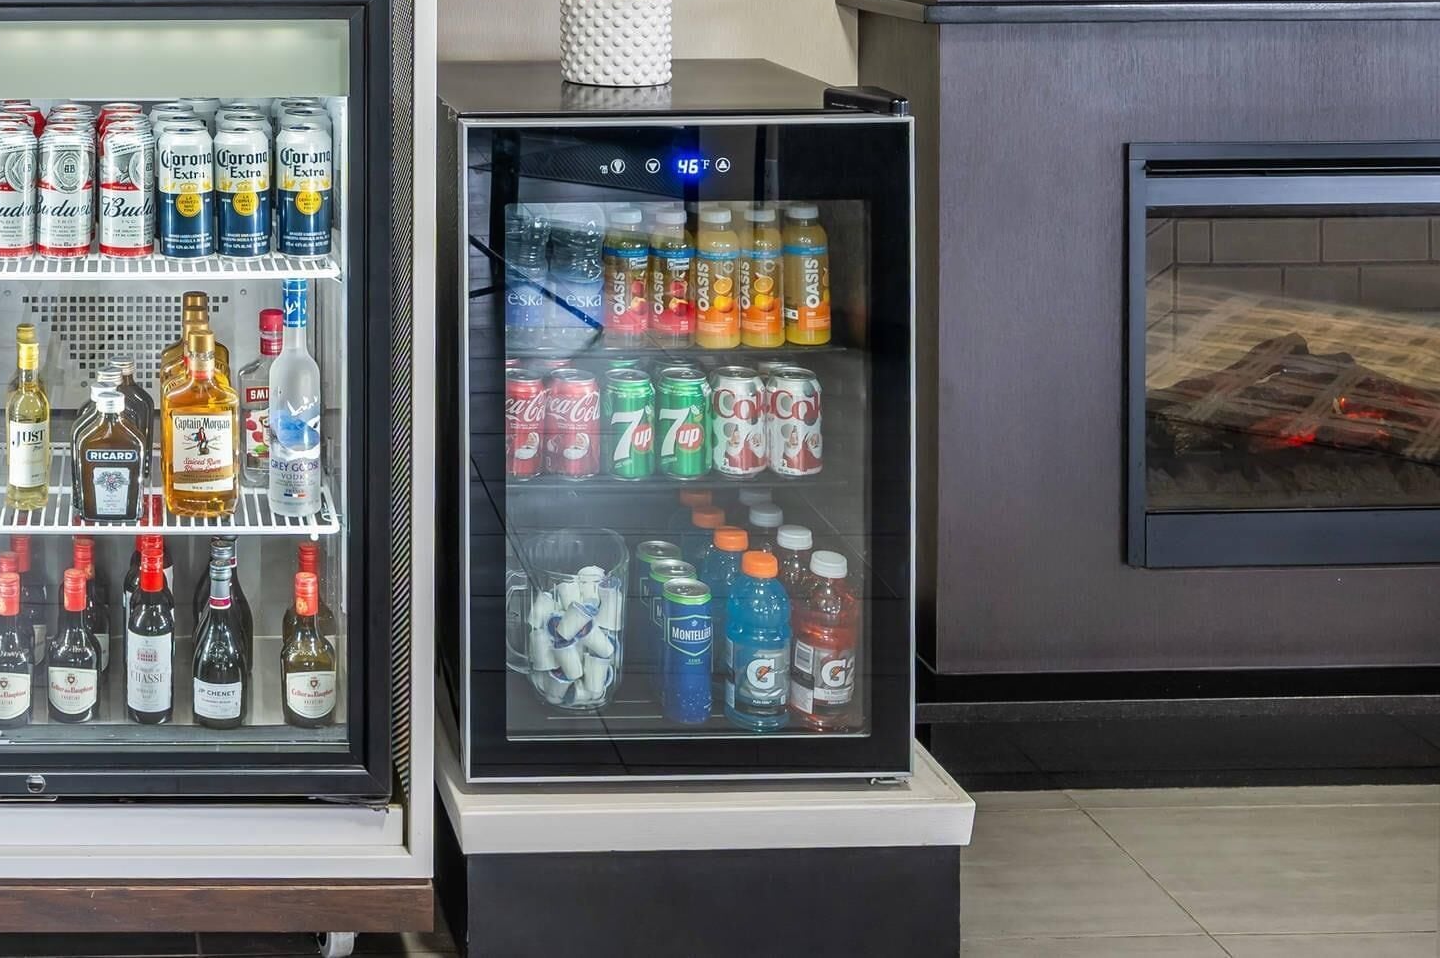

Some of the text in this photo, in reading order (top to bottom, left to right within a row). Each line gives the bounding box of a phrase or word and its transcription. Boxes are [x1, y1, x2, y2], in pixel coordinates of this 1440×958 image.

[161, 149, 211, 170] Corona
[217, 148, 268, 170] Corona
[280, 147, 332, 170] Corona
[677, 159, 698, 174] 46
[230, 167, 261, 178] Extra
[293, 165, 325, 177] Extra
[614, 272, 625, 316] OASIS
[654, 272, 664, 315] OASIS
[698, 261, 709, 312] OASIS
[741, 261, 751, 310] OASIS
[806, 259, 820, 309] OASIS
[174, 417, 230, 431] Captain Morgan
[90, 451, 133, 460] RICARD
[271, 458, 289, 472] GREY
[671, 626, 711, 641] MONTELLIER
